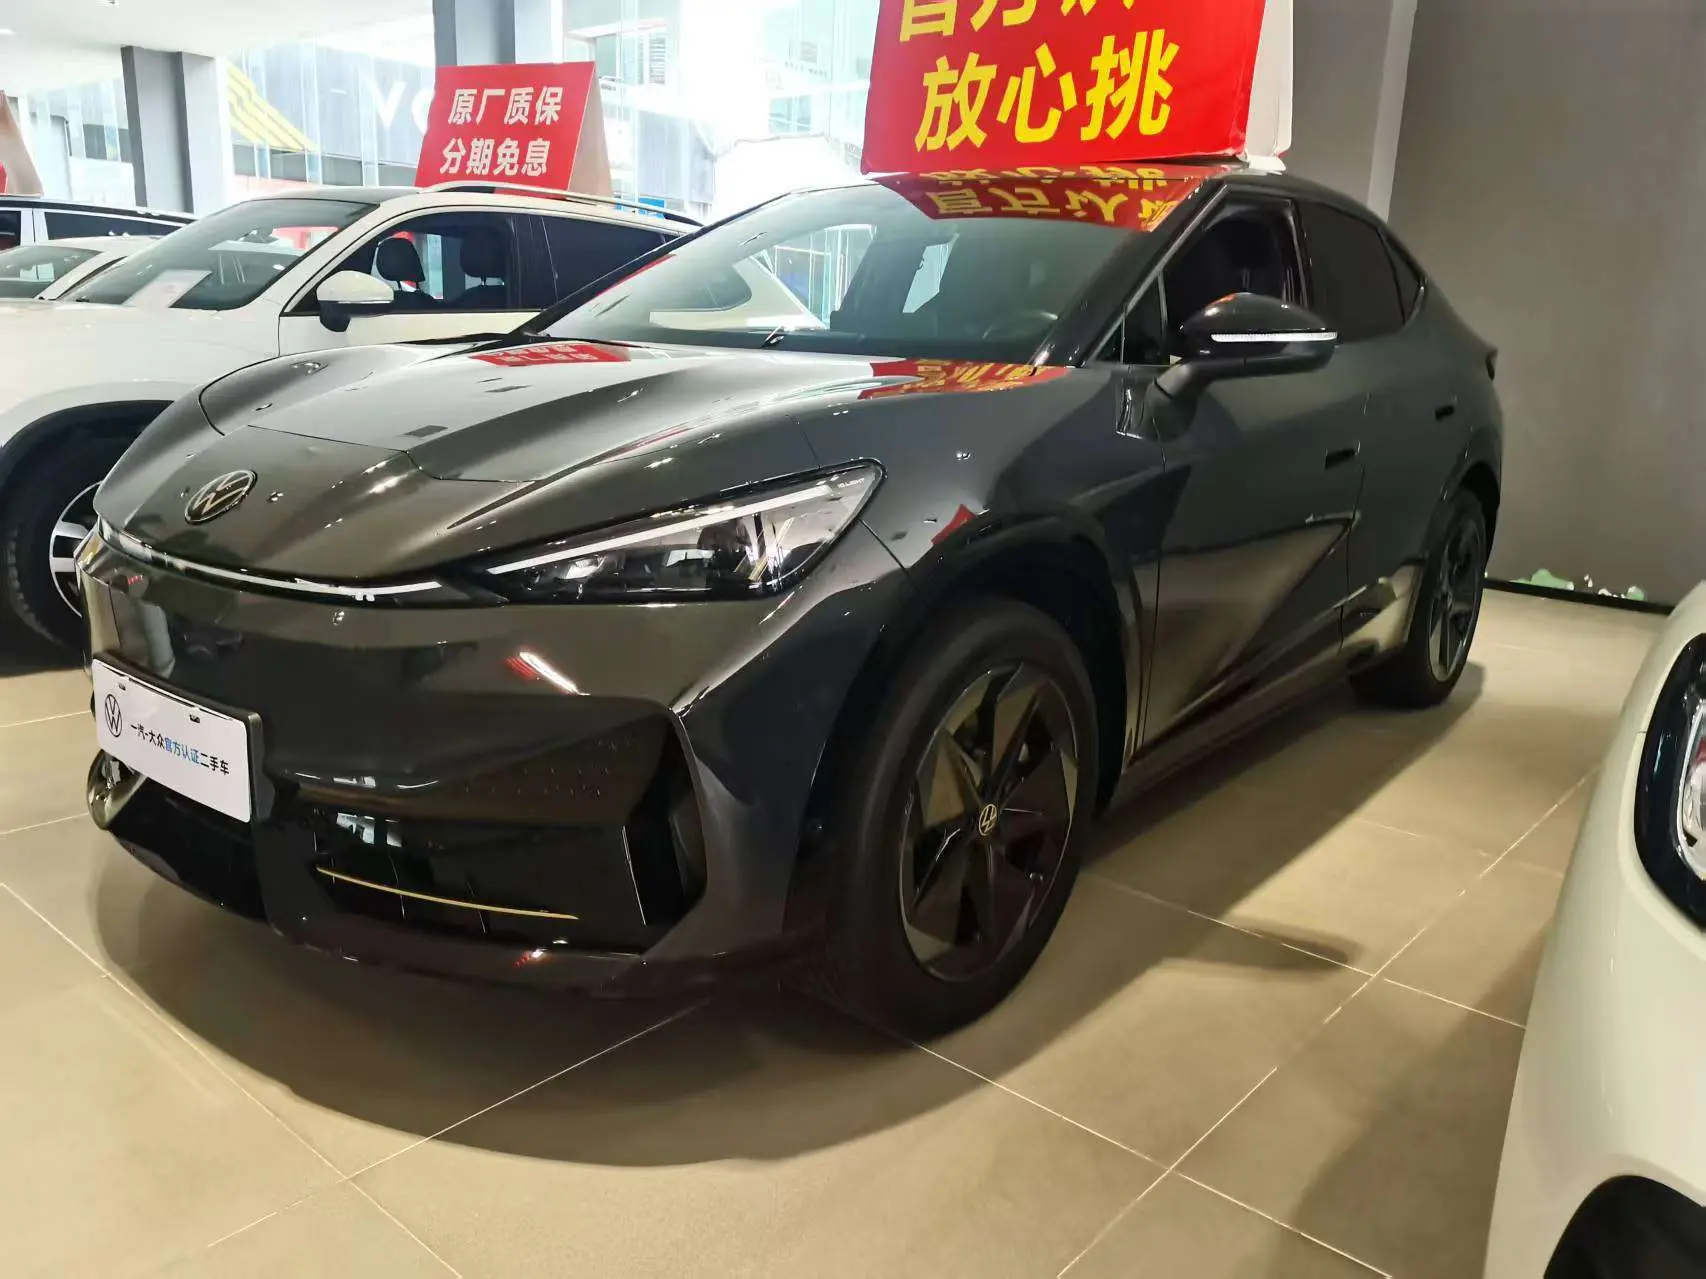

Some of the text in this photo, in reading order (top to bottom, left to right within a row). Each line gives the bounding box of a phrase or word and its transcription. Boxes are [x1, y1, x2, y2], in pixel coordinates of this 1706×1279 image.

[447, 86, 563, 126] 原厂质保
[914, 28, 1180, 152] 放心挑
[439, 137, 551, 177] 分期免息
